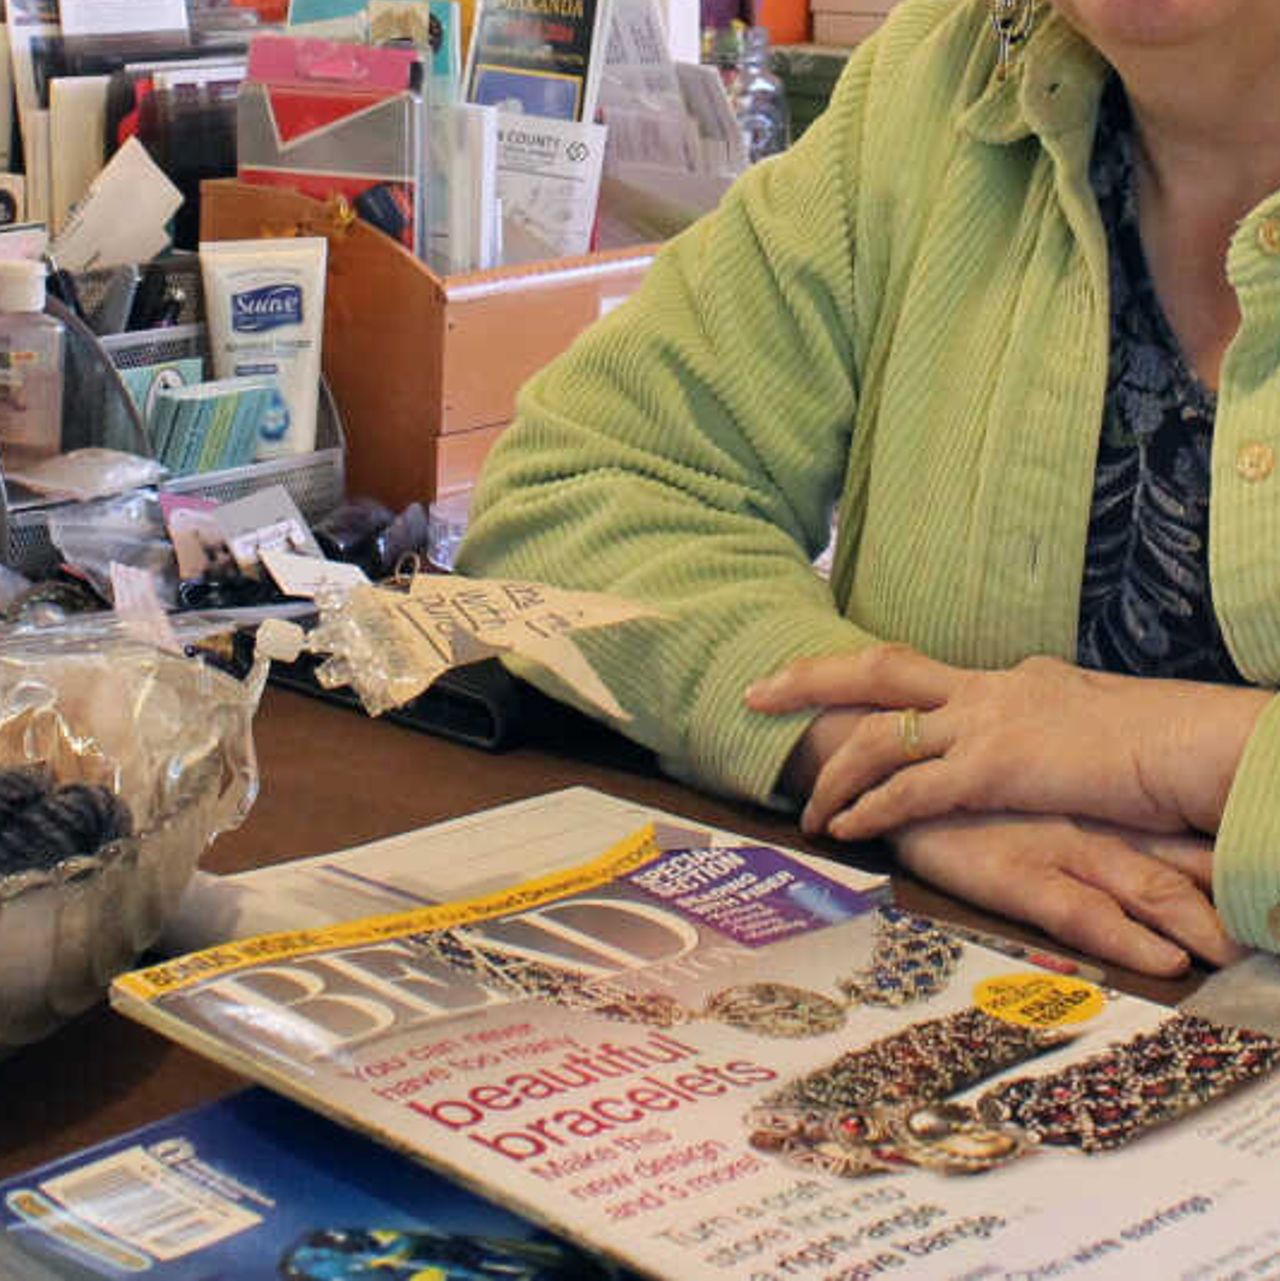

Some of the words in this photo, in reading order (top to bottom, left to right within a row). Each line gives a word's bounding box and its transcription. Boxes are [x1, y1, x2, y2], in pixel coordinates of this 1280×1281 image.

[507, 130, 562, 147] COUNTY
[236, 294, 298, 316] Suave
[631, 847, 730, 883] SPECIAL
[645, 850, 746, 897] SECTION
[182, 897, 700, 1060] BEAD
[353, 1056, 408, 1082] You
[371, 1066, 452, 1102] have
[449, 1048, 501, 1072] too
[406, 1029, 701, 1132] beautiful
[468, 1058, 779, 1163] bracelets
[529, 1146, 620, 1182] Make
[612, 1127, 673, 1154] this
[569, 1171, 636, 1200] new
[632, 1138, 729, 1180] design
[604, 1190, 667, 1220] and
